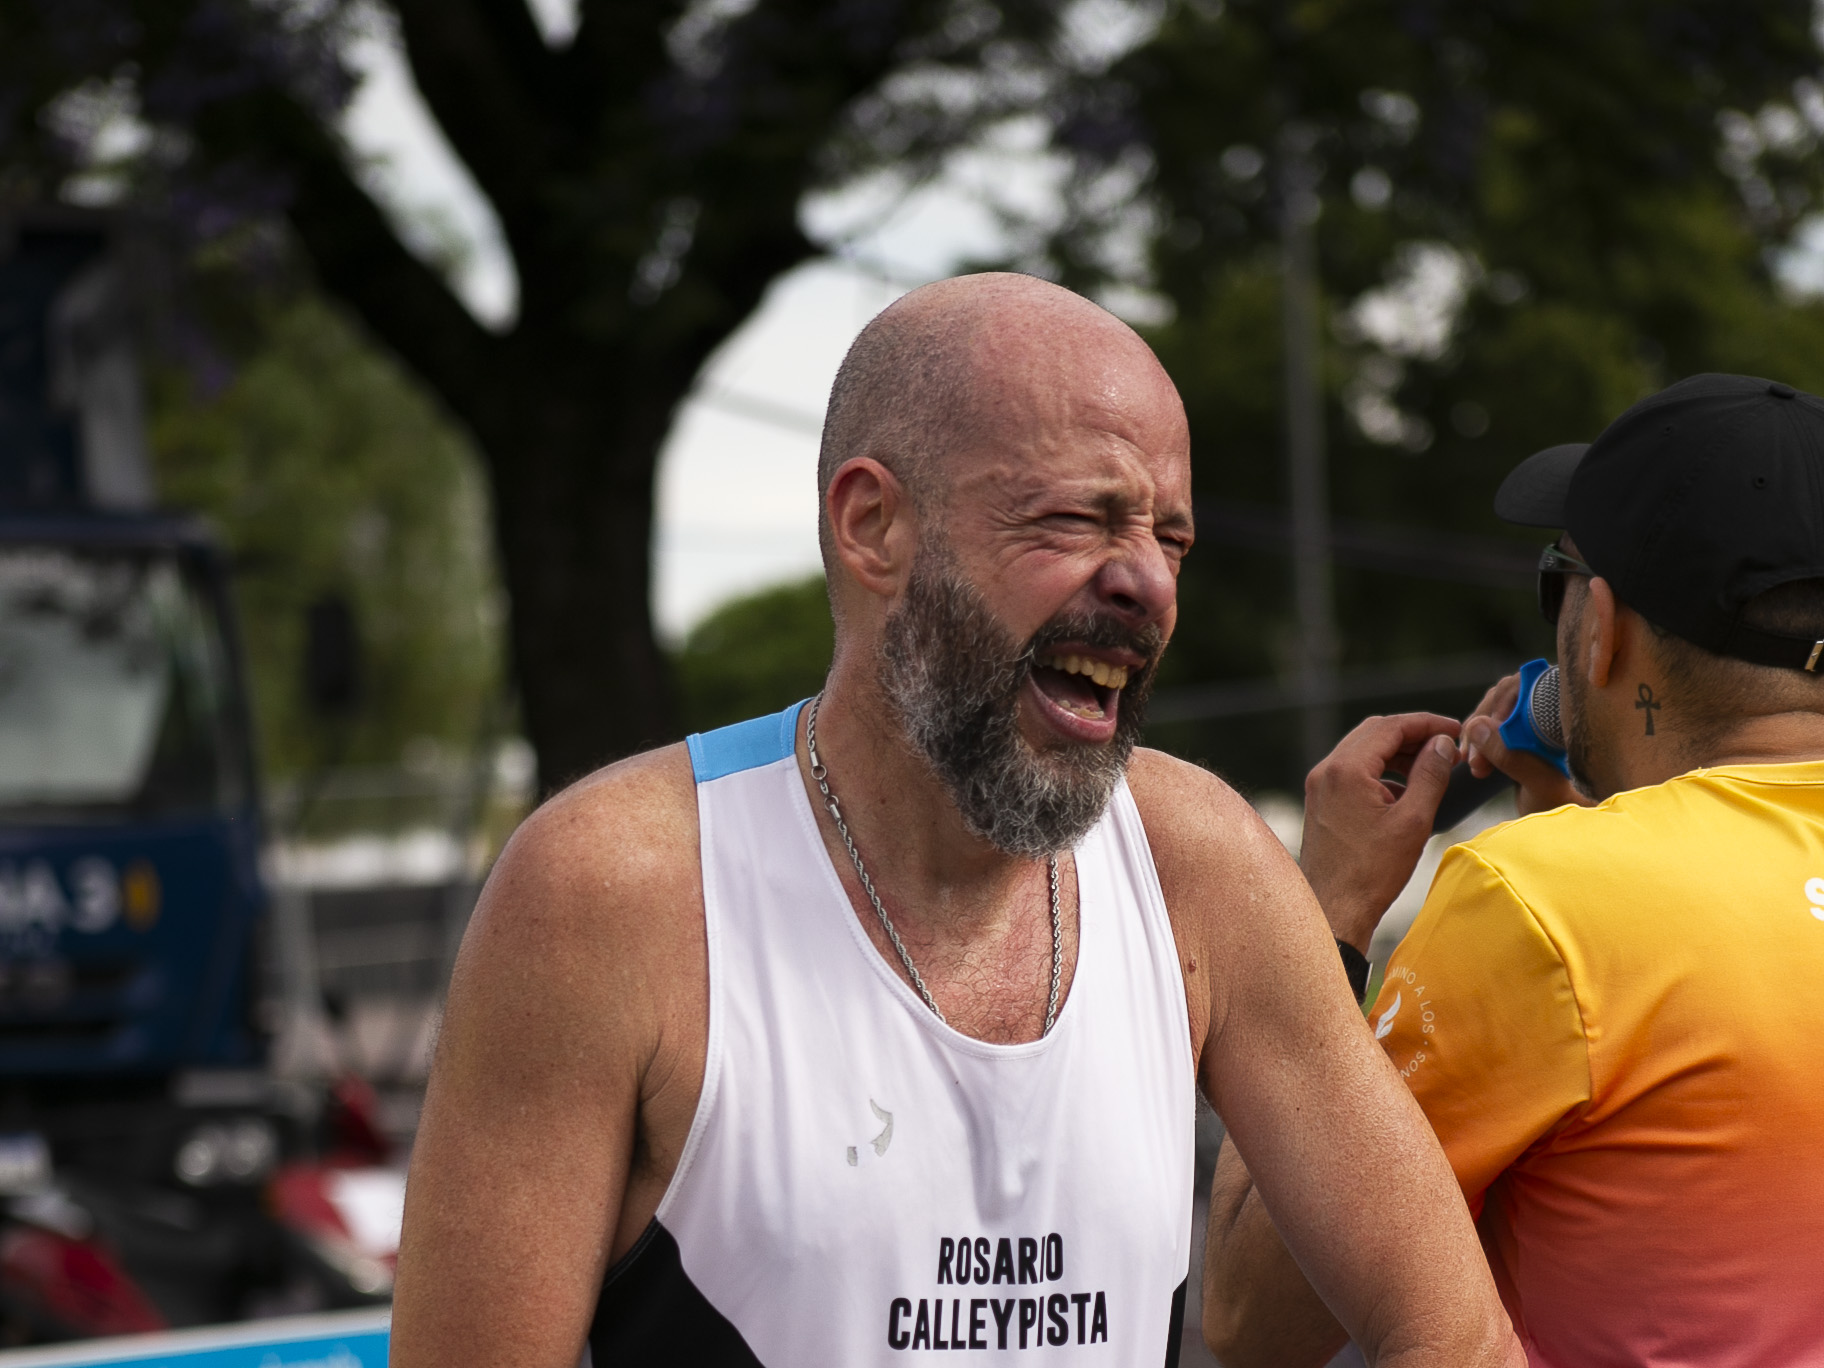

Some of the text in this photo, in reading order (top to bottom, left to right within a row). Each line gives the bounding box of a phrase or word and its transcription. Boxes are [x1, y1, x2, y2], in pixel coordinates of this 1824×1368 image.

[1420, 1000, 1435, 1034] LOS
[1400, 1051, 1426, 1078] NOS
[937, 1232, 1064, 1285] ROSARIO
[887, 1291, 1108, 1350] CALLEYPISTA
